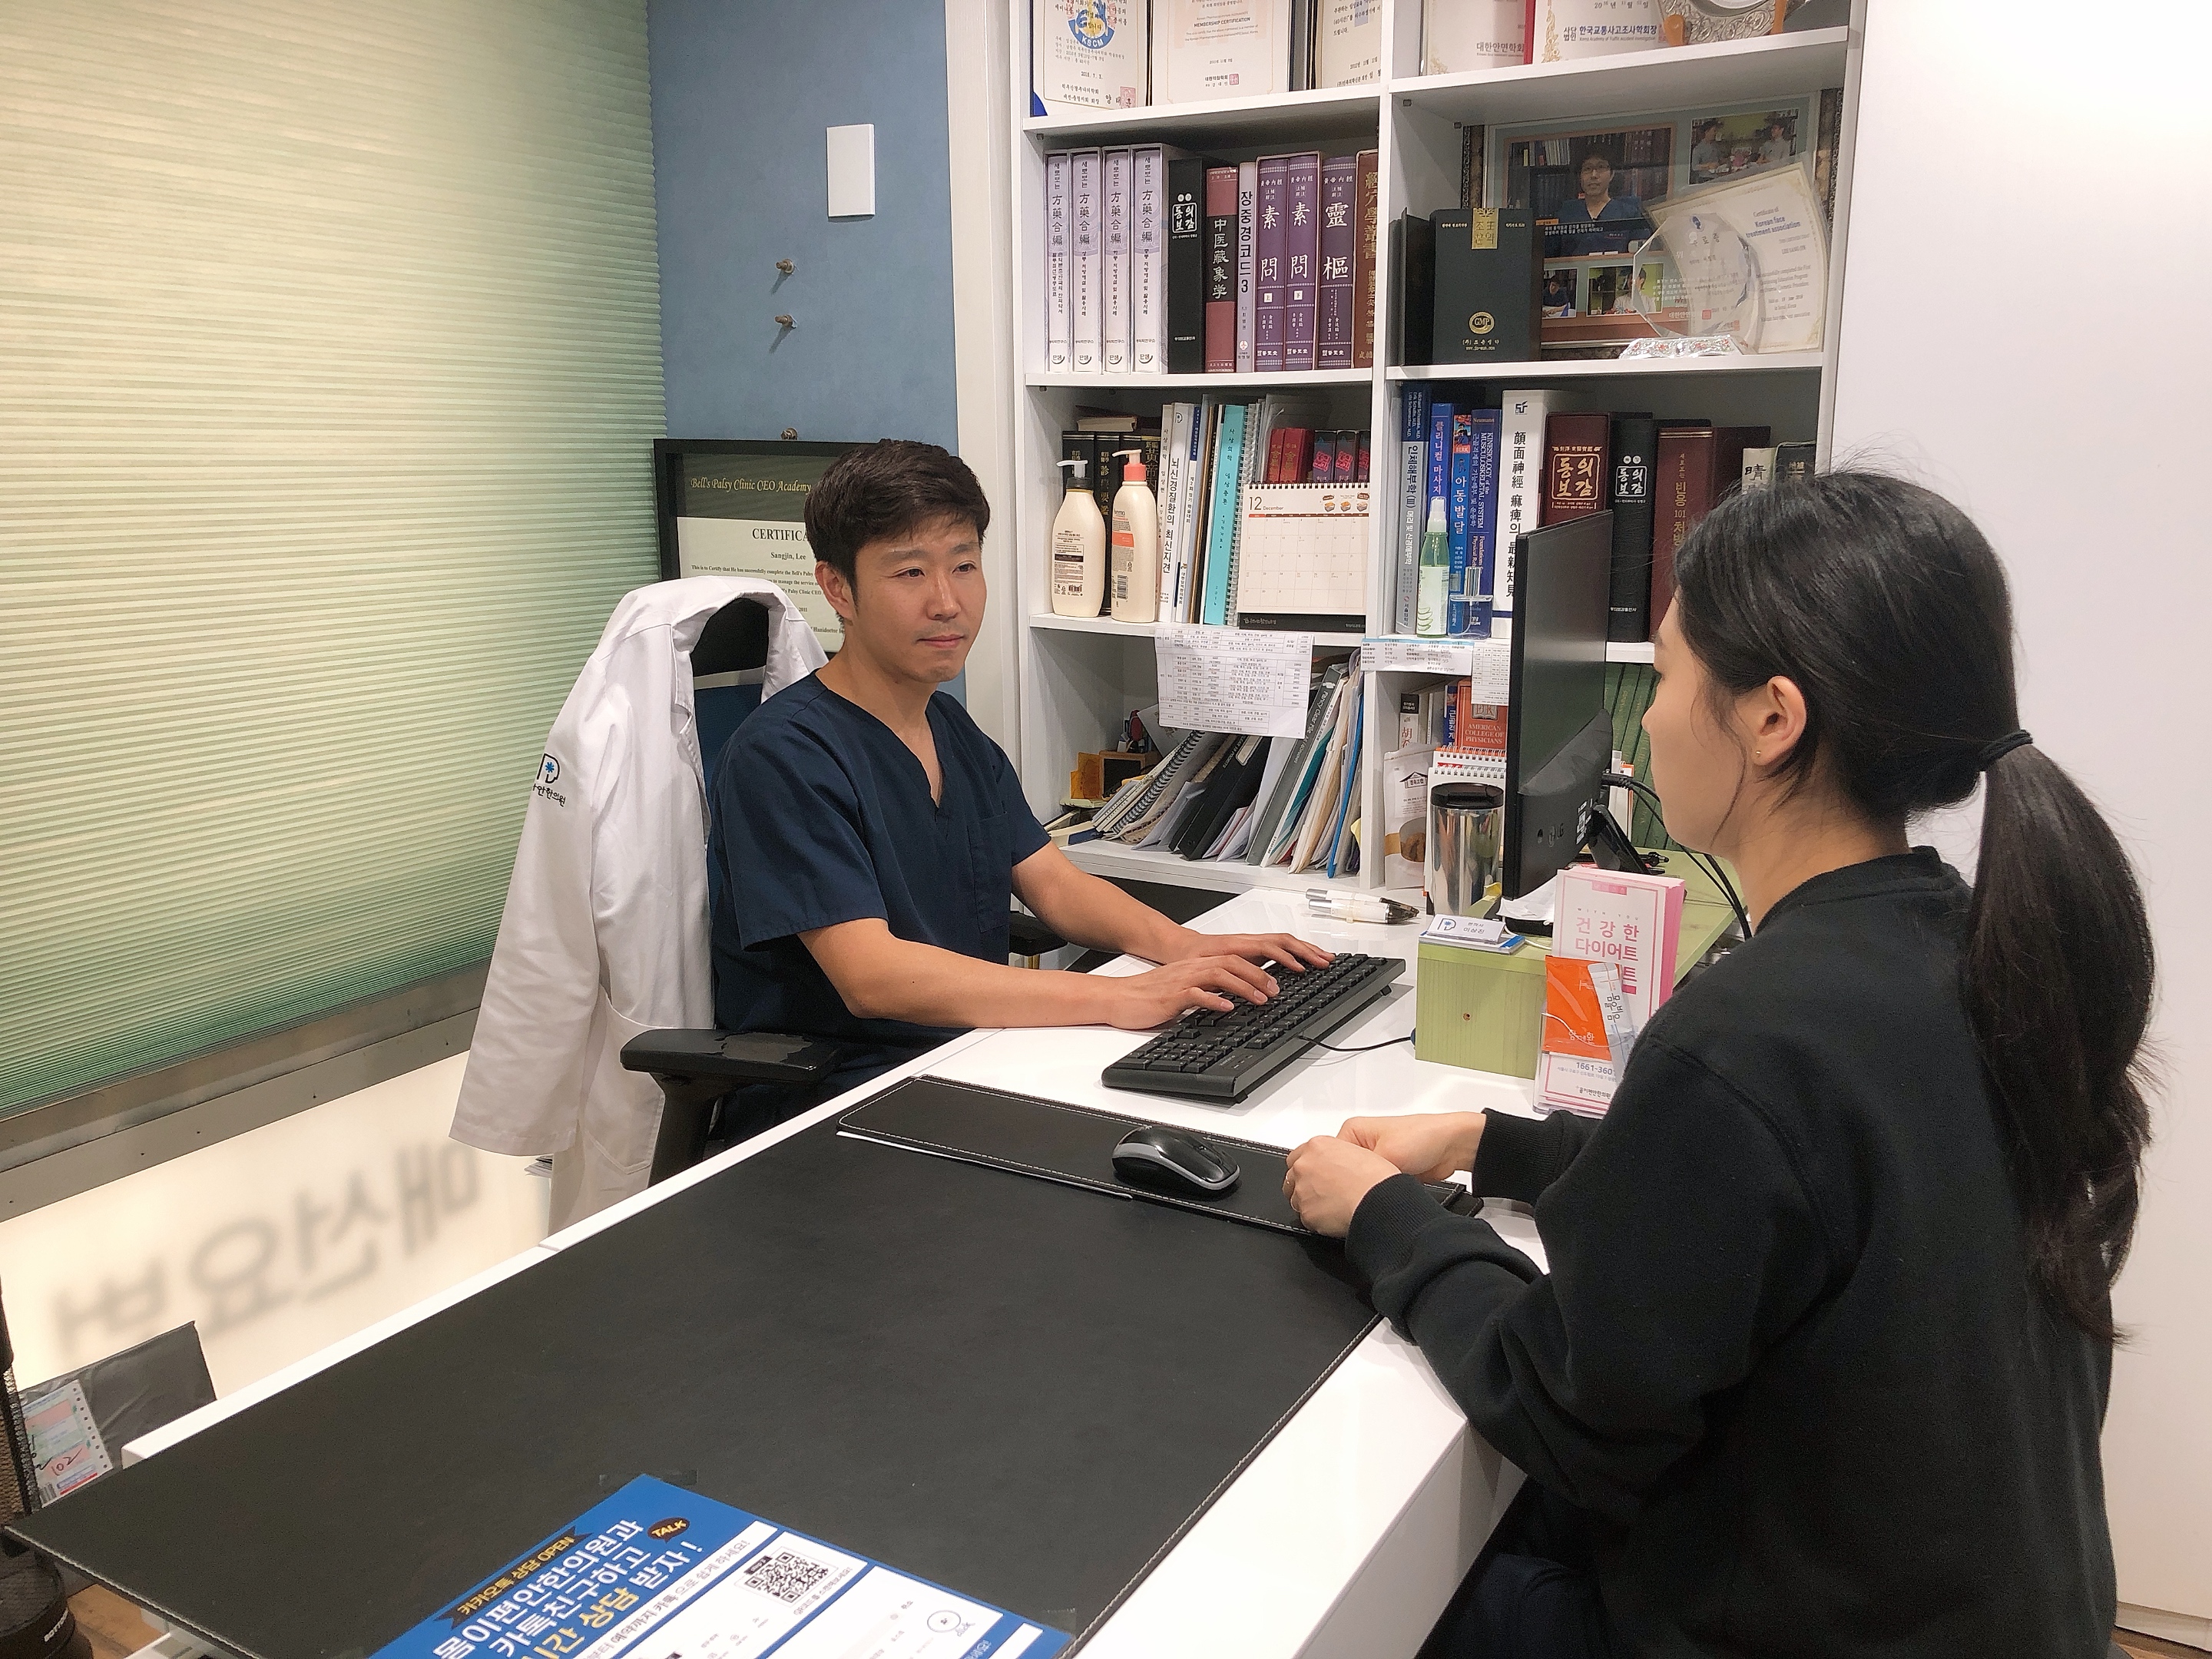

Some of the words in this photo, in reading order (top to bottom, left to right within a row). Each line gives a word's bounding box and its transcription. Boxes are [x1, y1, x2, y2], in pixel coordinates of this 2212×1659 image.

[1081, 35, 1104, 47] KSCM
[1240, 191, 1253, 275] 장중경코드
[1746, 228, 1771, 238] treatment
[1772, 221, 1800, 233] association
[1774, 216, 1785, 224] face
[1260, 204, 1280, 282] 素問
[1291, 201, 1310, 280] 素問
[1323, 201, 1349, 281] 靈樞
[1241, 279, 1249, 293] 3
[1474, 317, 1490, 326] GMP
[1435, 421, 1444, 461] 클리니컬
[1406, 445, 1418, 494] 인체해부학
[1479, 432, 1487, 500] MUSCULOSKELETAL
[1511, 431, 1526, 488] 顔面神經
[691, 477, 710, 489] Bell's
[711, 478, 732, 493] Palsy
[733, 478, 756, 491] Clinic
[757, 480, 776, 492] CEO
[777, 480, 812, 495] Academy
[1167, 458, 1180, 525] 뇌신경질환의
[1433, 465, 1443, 495] 마사지
[1674, 482, 1687, 507] 빈용
[1249, 496, 1262, 511] 12
[1406, 511, 1414, 524] 머리
[1453, 476, 1467, 534] 아동발달
[1674, 509, 1687, 518] 101
[770, 551, 794, 560] Sangjin,
[1163, 529, 1174, 574] 최신지견
[1405, 533, 1413, 565] 신경해부학
[1316, 690, 1329, 710] Fancy
[1306, 720, 1315, 734] File
[1310, 709, 1321, 724] Clear
[1575, 938, 1638, 962] 다이어트
[1576, 1061, 1615, 1077] 1661-360
[651, 1520, 687, 1538] TALK
[433, 1519, 644, 1659] 몸이편안한의원과
[457, 1575, 515, 1615] 카카오톡
[512, 1557, 541, 1579] 상담
[537, 1536, 575, 1562] OPEN
[578, 1587, 641, 1628] 상담
[628, 1549, 691, 1590] 받자
[488, 1545, 653, 1658] 카톡친구하고
[611, 1611, 658, 1644] 예약까지
[654, 1593, 679, 1614] 카톡
[675, 1578, 699, 1596] 으로
[717, 1538, 751, 1565] 하세요!
